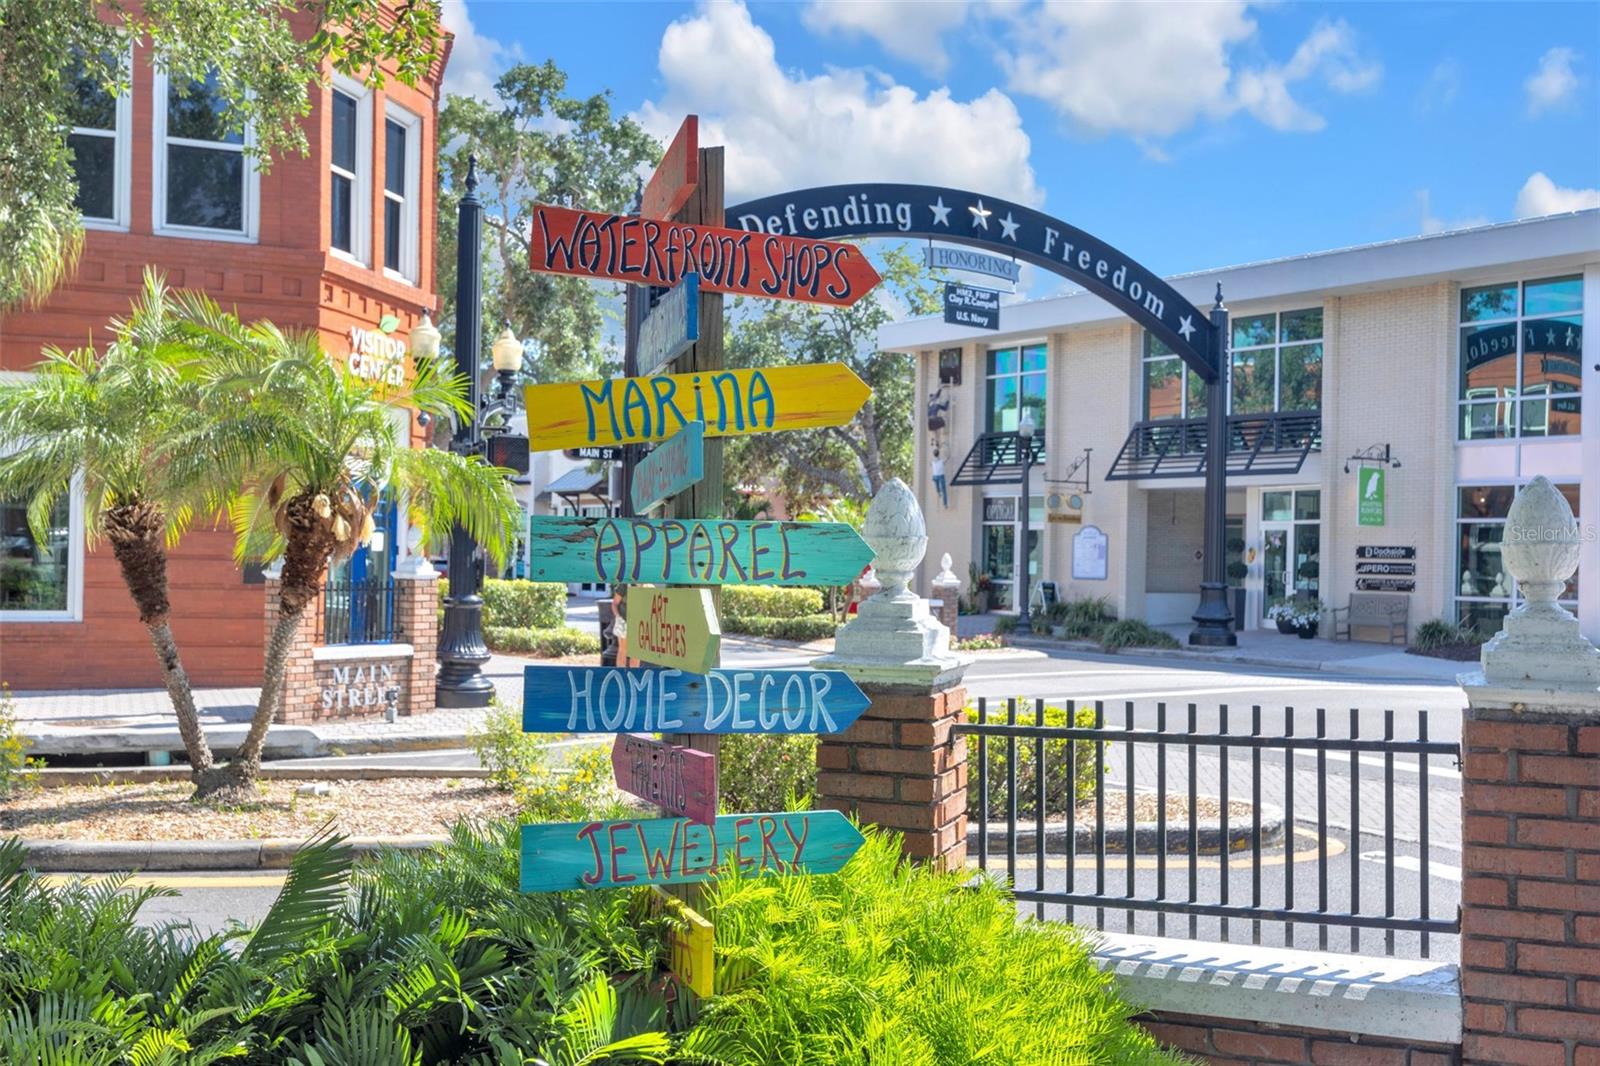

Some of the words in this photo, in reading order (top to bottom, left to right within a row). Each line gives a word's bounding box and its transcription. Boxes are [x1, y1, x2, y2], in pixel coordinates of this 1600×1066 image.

[738, 193, 912, 236] Defending
[761, 235, 850, 300] SHOPS
[939, 249, 1013, 275] HONORING
[1043, 226, 1165, 320] Freedom
[948, 294, 963, 306] Clay
[955, 311, 970, 322] U.S.
[971, 312, 989, 327] Navy
[351, 326, 406, 363] VISITOR
[349, 352, 404, 387] CENTER
[579, 447, 600, 459] MAIN
[602, 449, 614, 459] ST
[595, 519, 807, 582] APPAREL
[650, 593, 669, 620] ART
[638, 621, 687, 658] GALLERIES
[331, 663, 393, 685] MAIN
[566, 668, 683, 732] HOME
[704, 671, 838, 734] DECOR
[576, 816, 809, 886] JEWELERY
